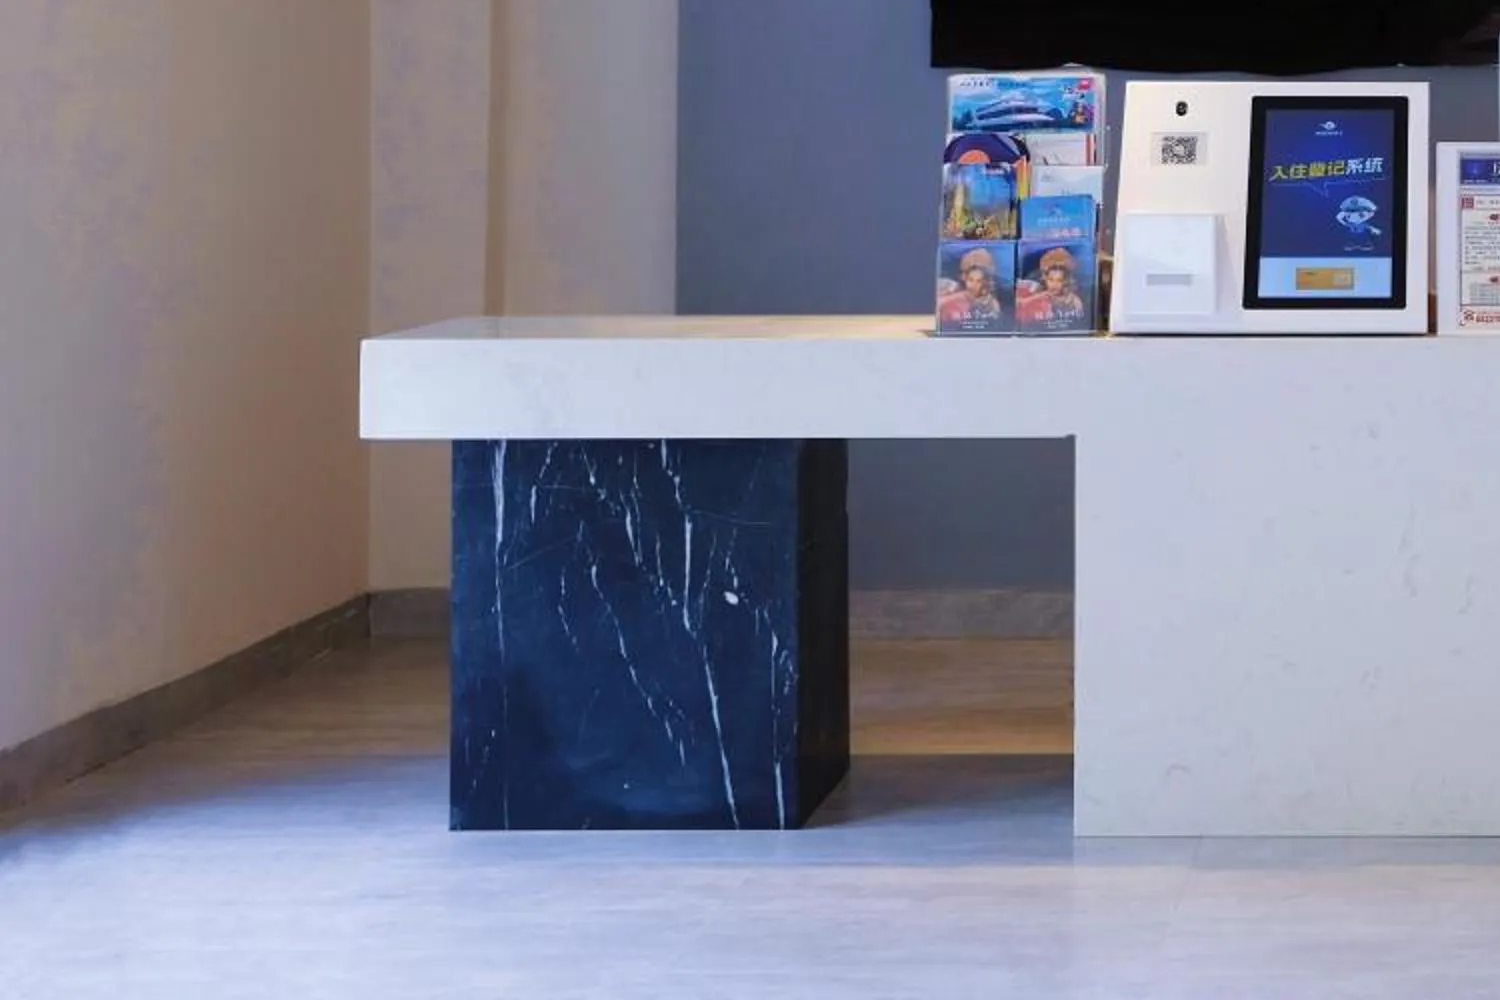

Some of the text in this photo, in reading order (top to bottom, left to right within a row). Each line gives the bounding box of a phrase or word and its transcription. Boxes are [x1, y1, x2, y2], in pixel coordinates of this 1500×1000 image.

[1268, 157, 1384, 181] 入住登记系统
